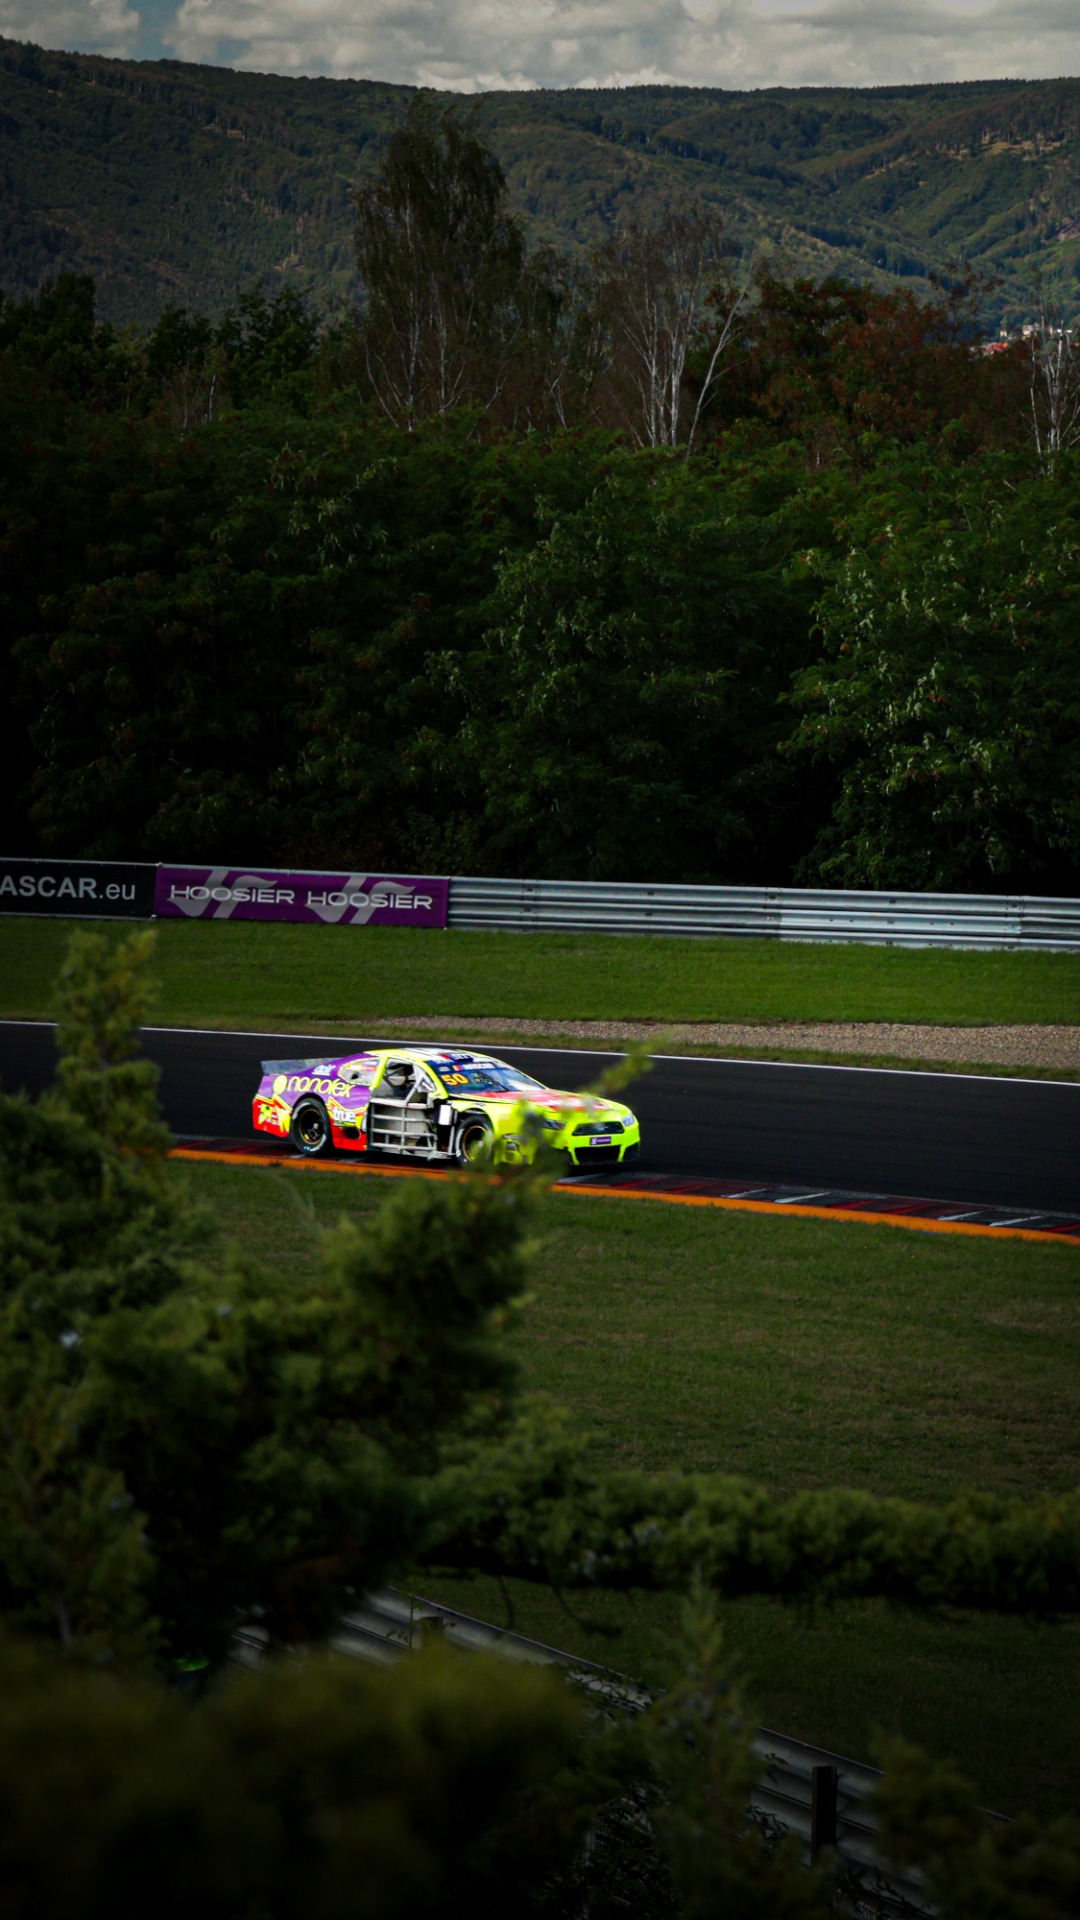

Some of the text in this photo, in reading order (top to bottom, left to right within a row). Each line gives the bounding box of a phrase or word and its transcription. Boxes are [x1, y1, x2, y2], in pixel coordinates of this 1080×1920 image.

[170, 884, 434, 910] HOOSIER HOOSIER
[441, 1073, 469, 1086] 50
[332, 1106, 356, 1122] true
